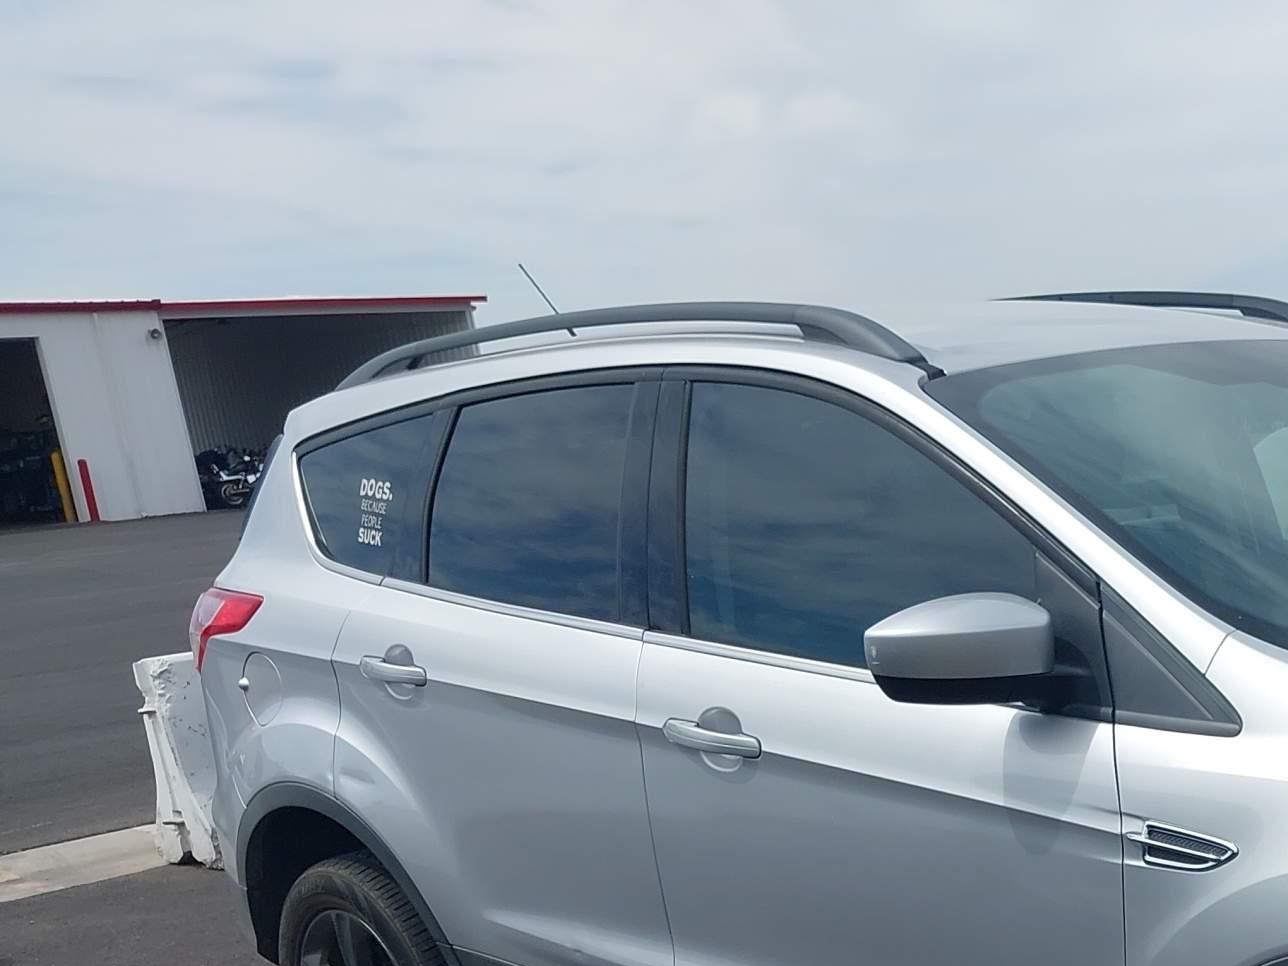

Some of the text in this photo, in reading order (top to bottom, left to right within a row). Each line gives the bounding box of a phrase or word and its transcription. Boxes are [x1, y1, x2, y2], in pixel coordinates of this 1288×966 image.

[360, 498, 387, 515] BECAUSE
[360, 513, 382, 529] PEOPLE
[357, 527, 383, 547] SUCK
